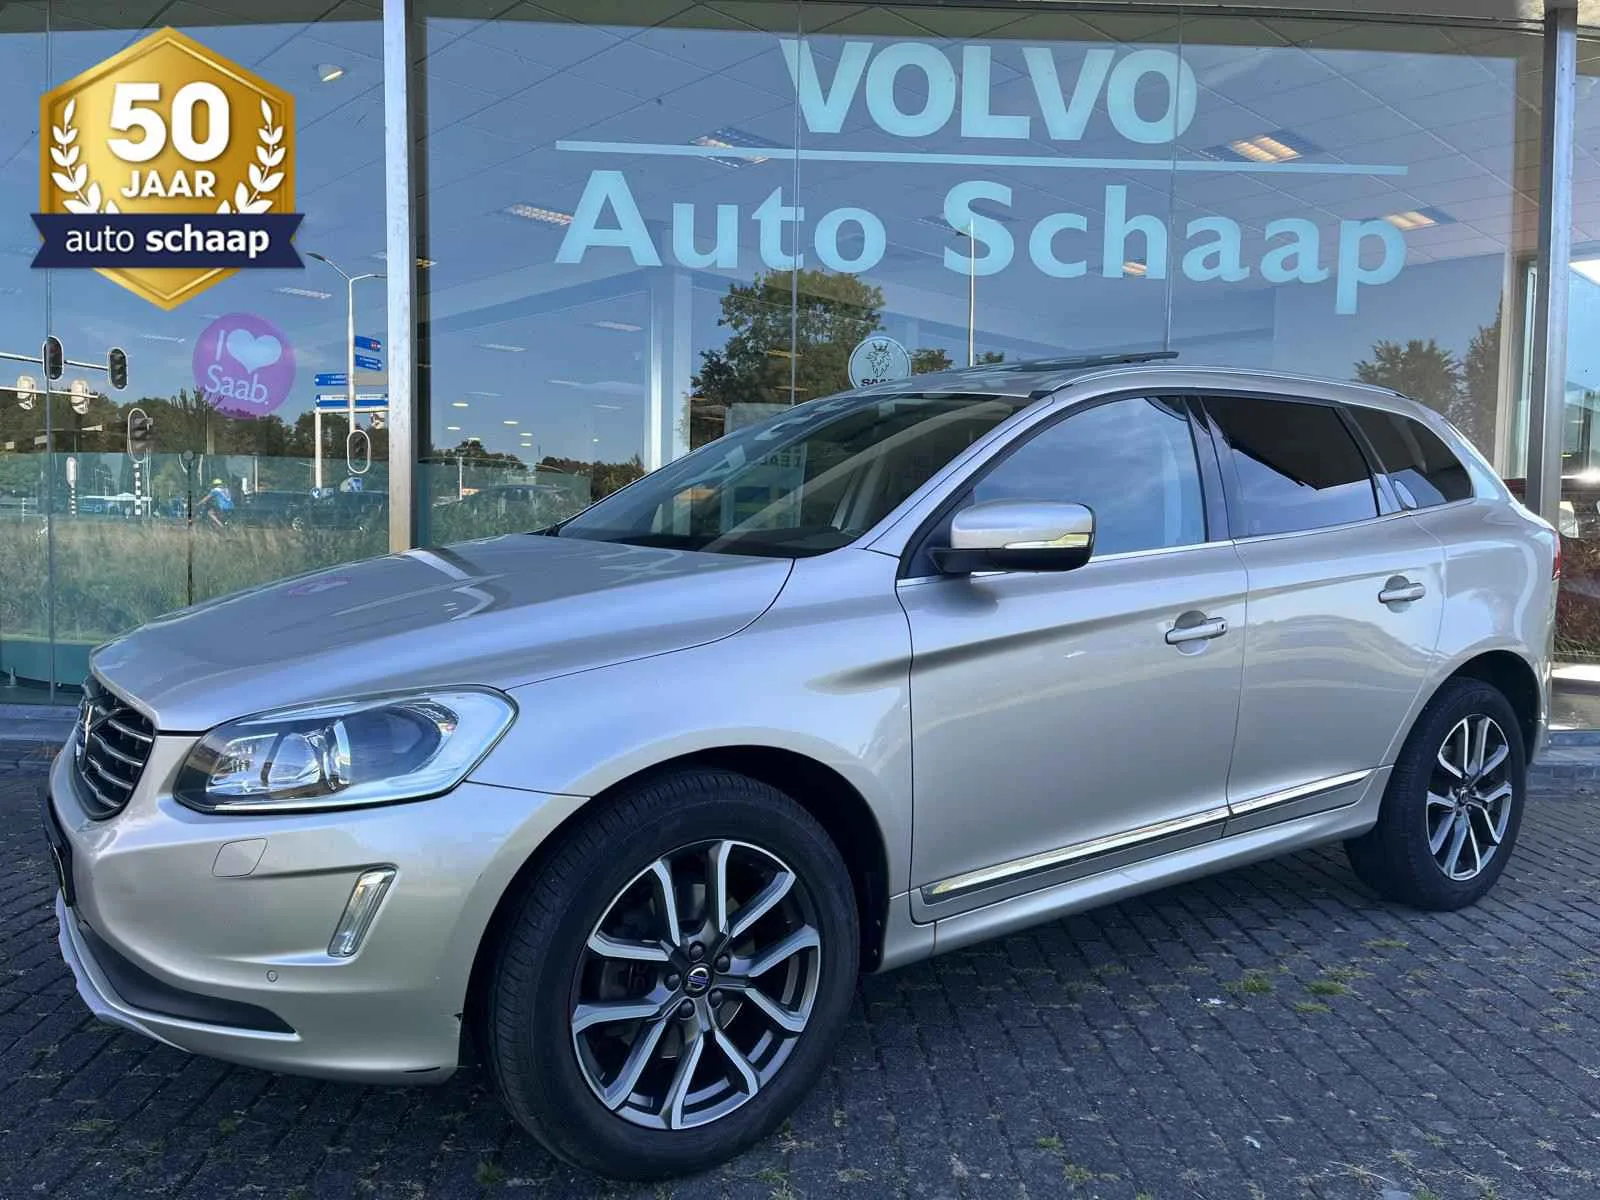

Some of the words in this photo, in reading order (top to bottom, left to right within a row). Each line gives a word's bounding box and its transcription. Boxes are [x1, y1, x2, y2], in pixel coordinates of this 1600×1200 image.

[779, 38, 1198, 144] VOLVO
[554, 169, 887, 274] Auto
[943, 180, 1409, 315] Schaap
[215, 329, 226, 362] I
[861, 378, 893, 387] SA
